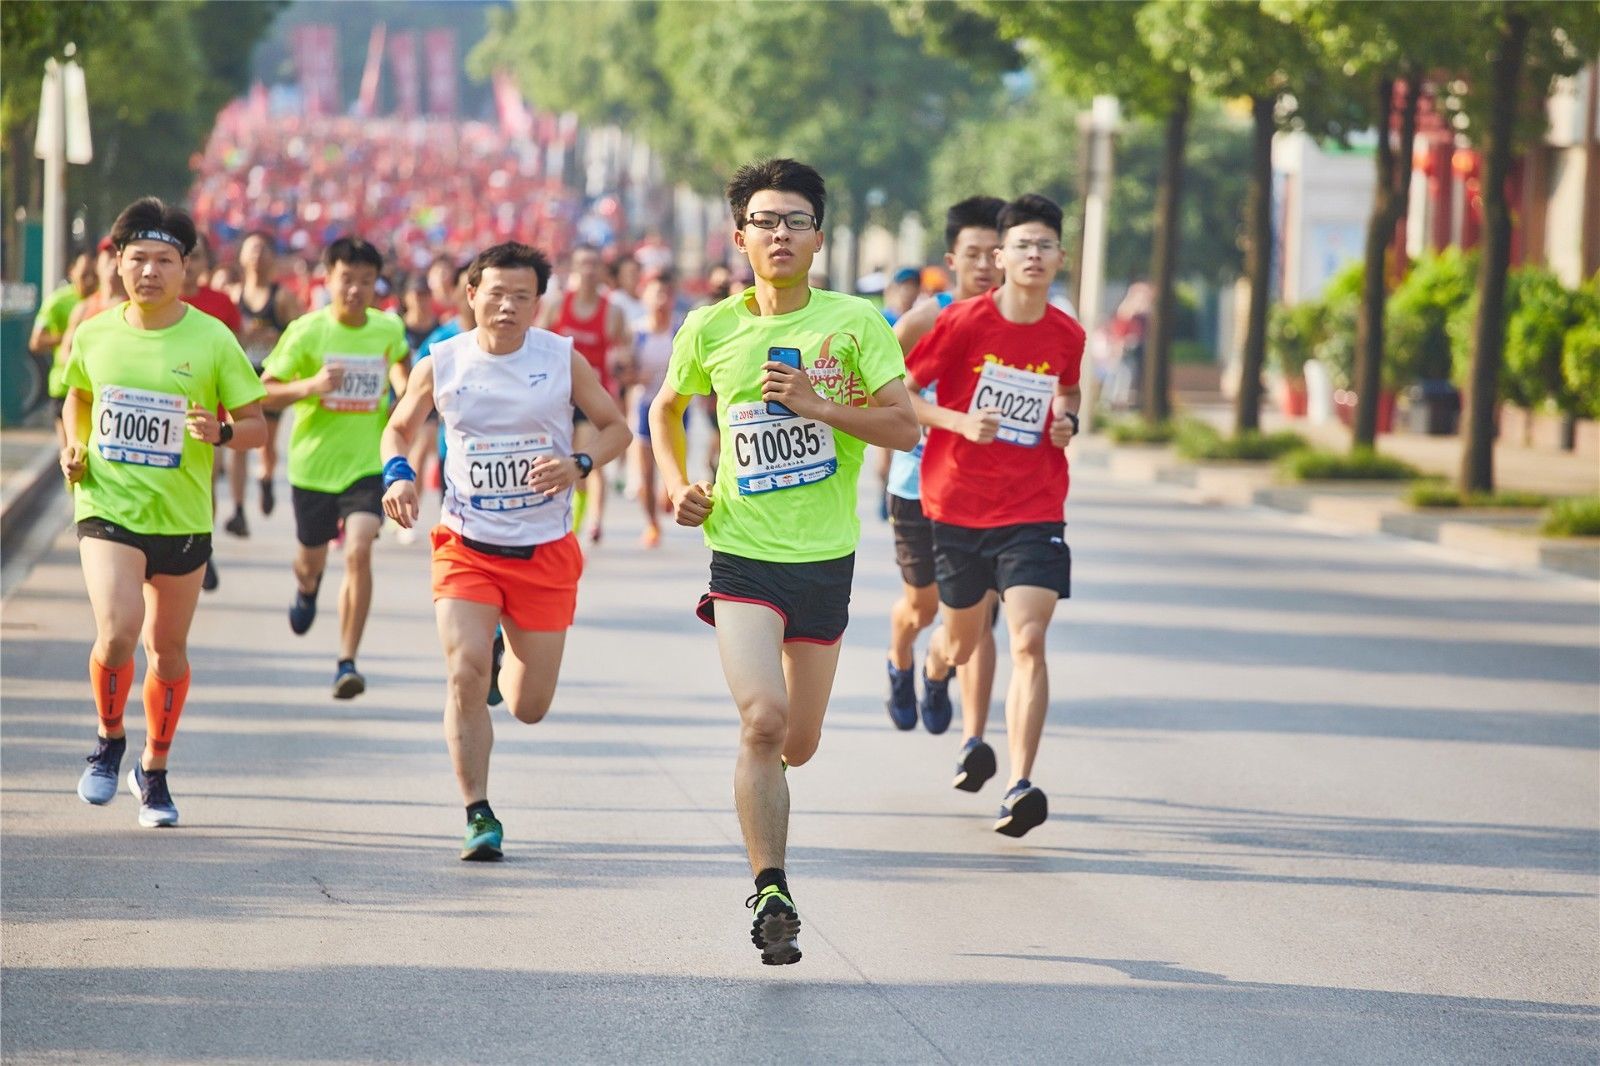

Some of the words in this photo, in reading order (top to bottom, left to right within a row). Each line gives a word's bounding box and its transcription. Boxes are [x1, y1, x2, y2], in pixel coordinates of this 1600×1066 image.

[976, 385, 1042, 424] C10223
[100, 408, 171, 446] C10061
[735, 422, 820, 467] C10035
